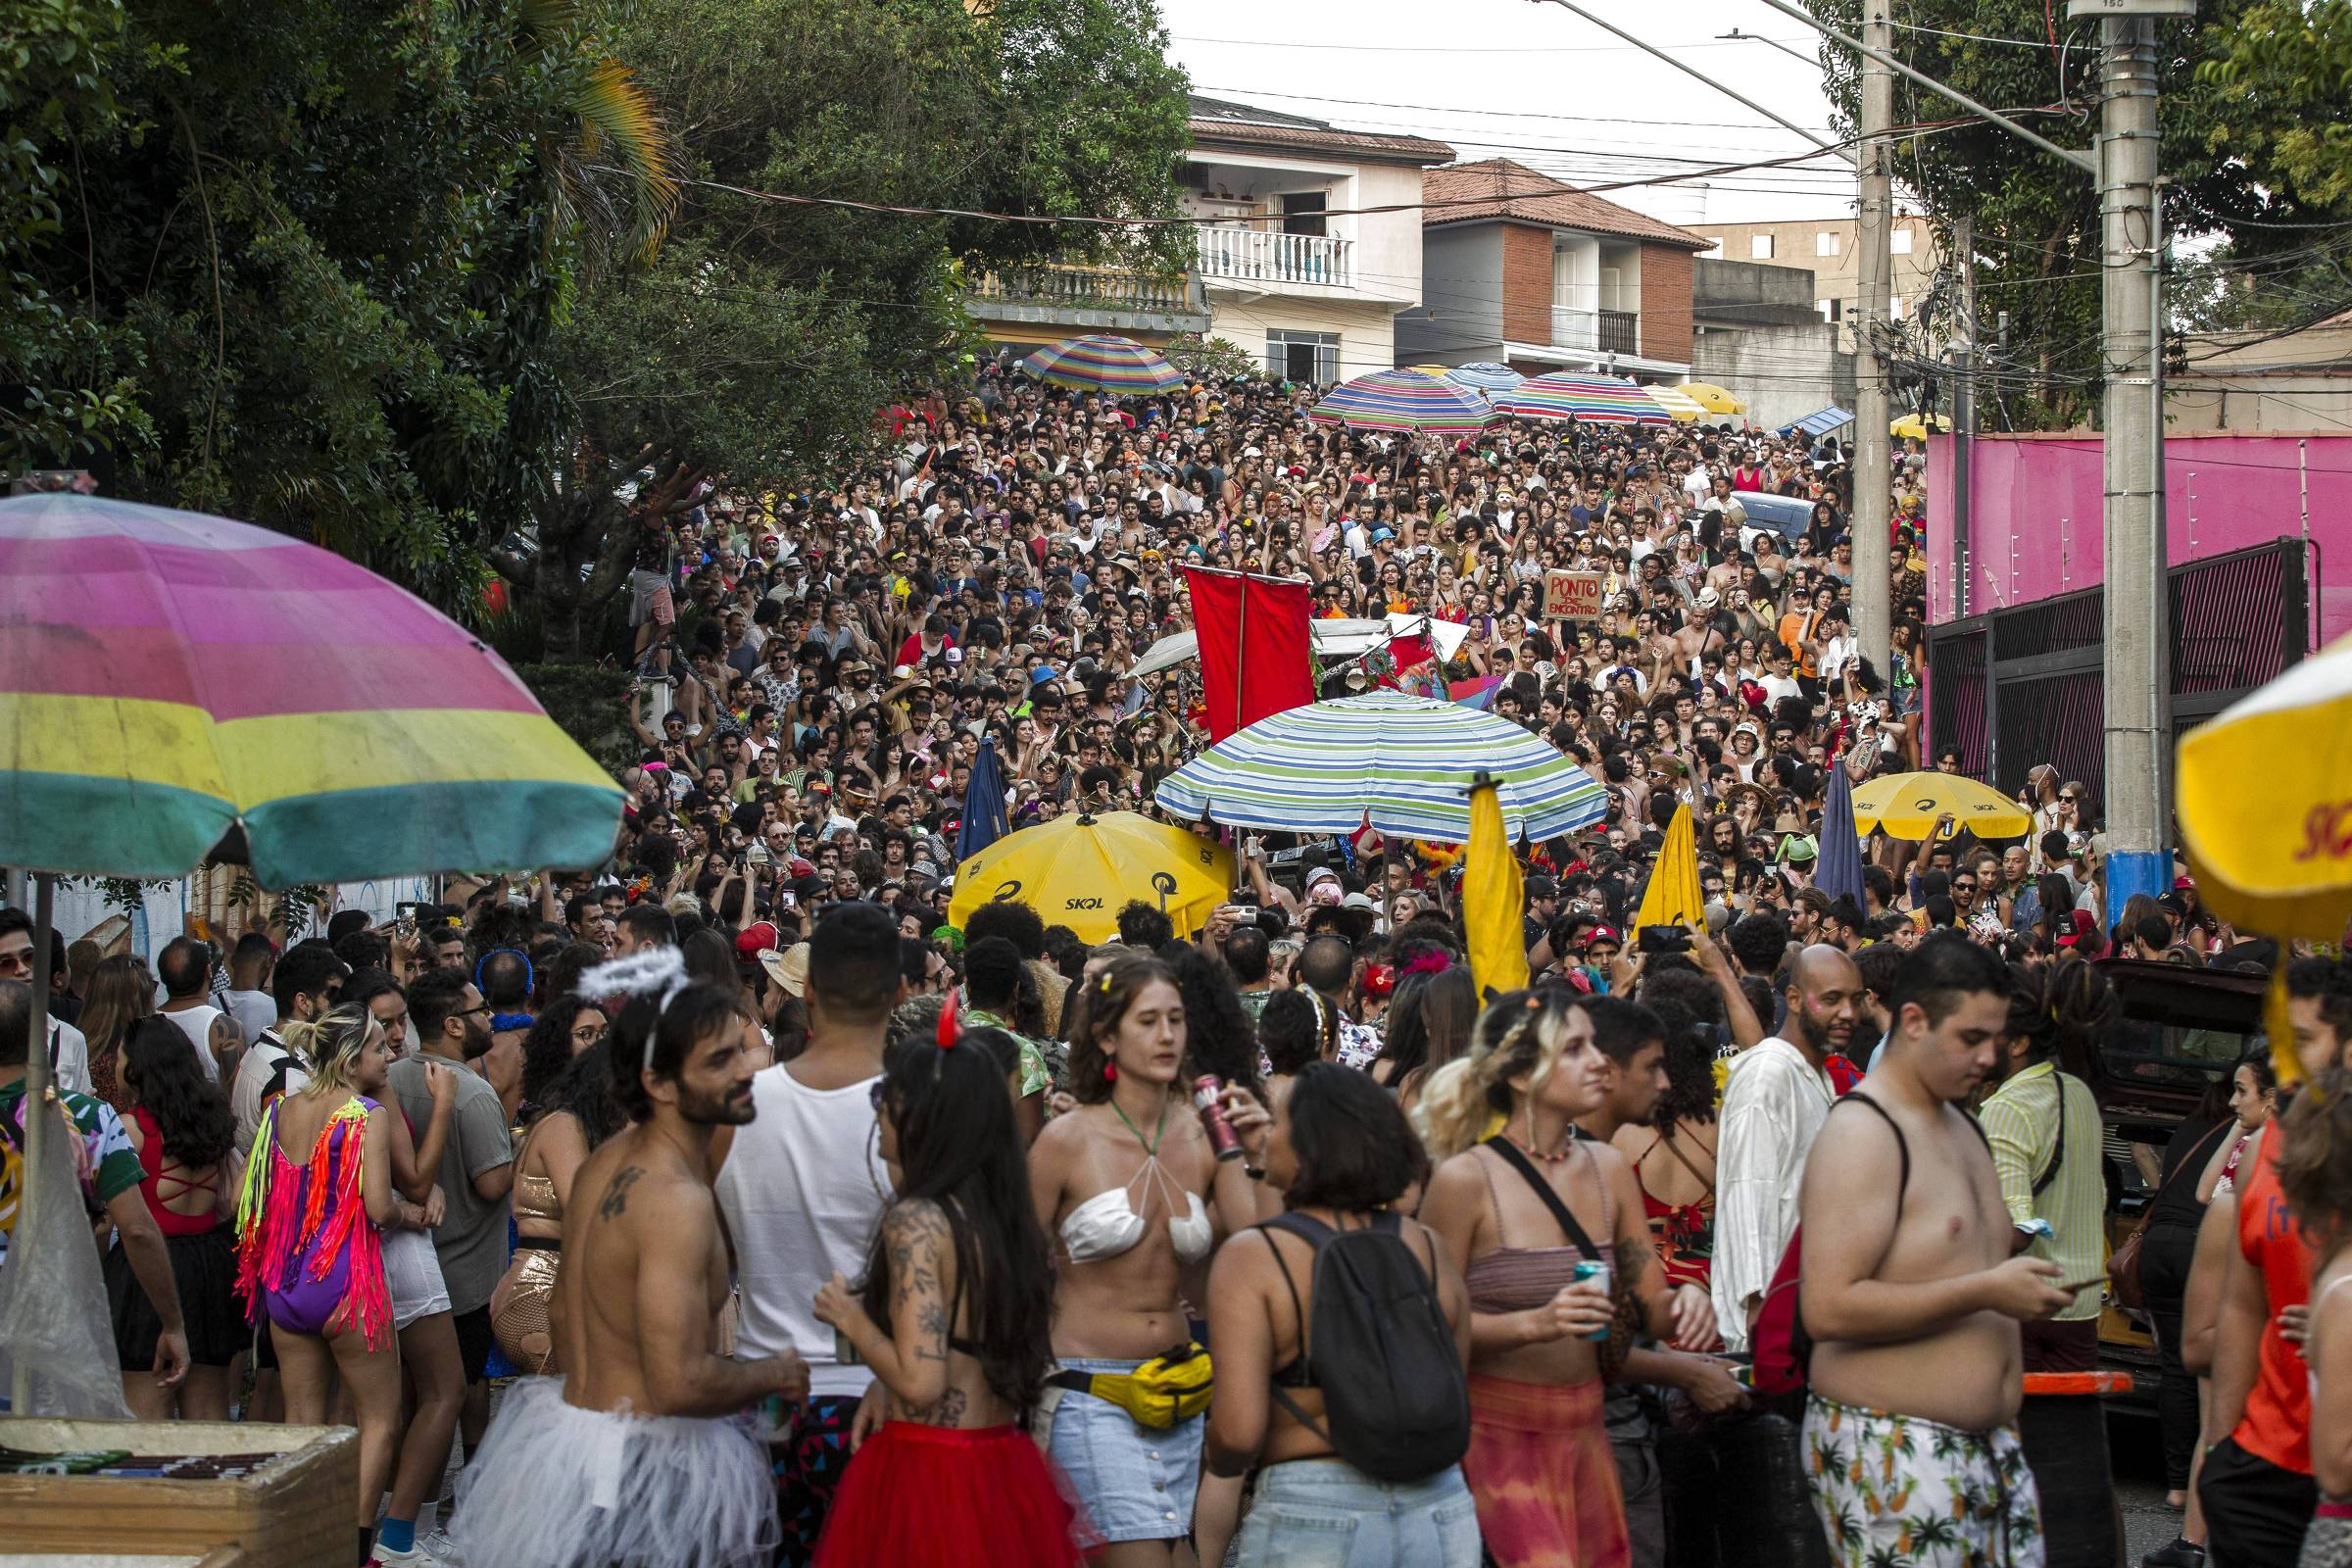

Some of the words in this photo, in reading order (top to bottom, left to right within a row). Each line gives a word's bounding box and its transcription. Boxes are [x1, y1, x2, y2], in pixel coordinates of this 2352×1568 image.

[1550, 577, 1598, 598] PONTO
[1560, 596, 1583, 606] DE
[1548, 604, 1597, 615] ENCONTRO
[1065, 898, 1104, 910] SKOL
